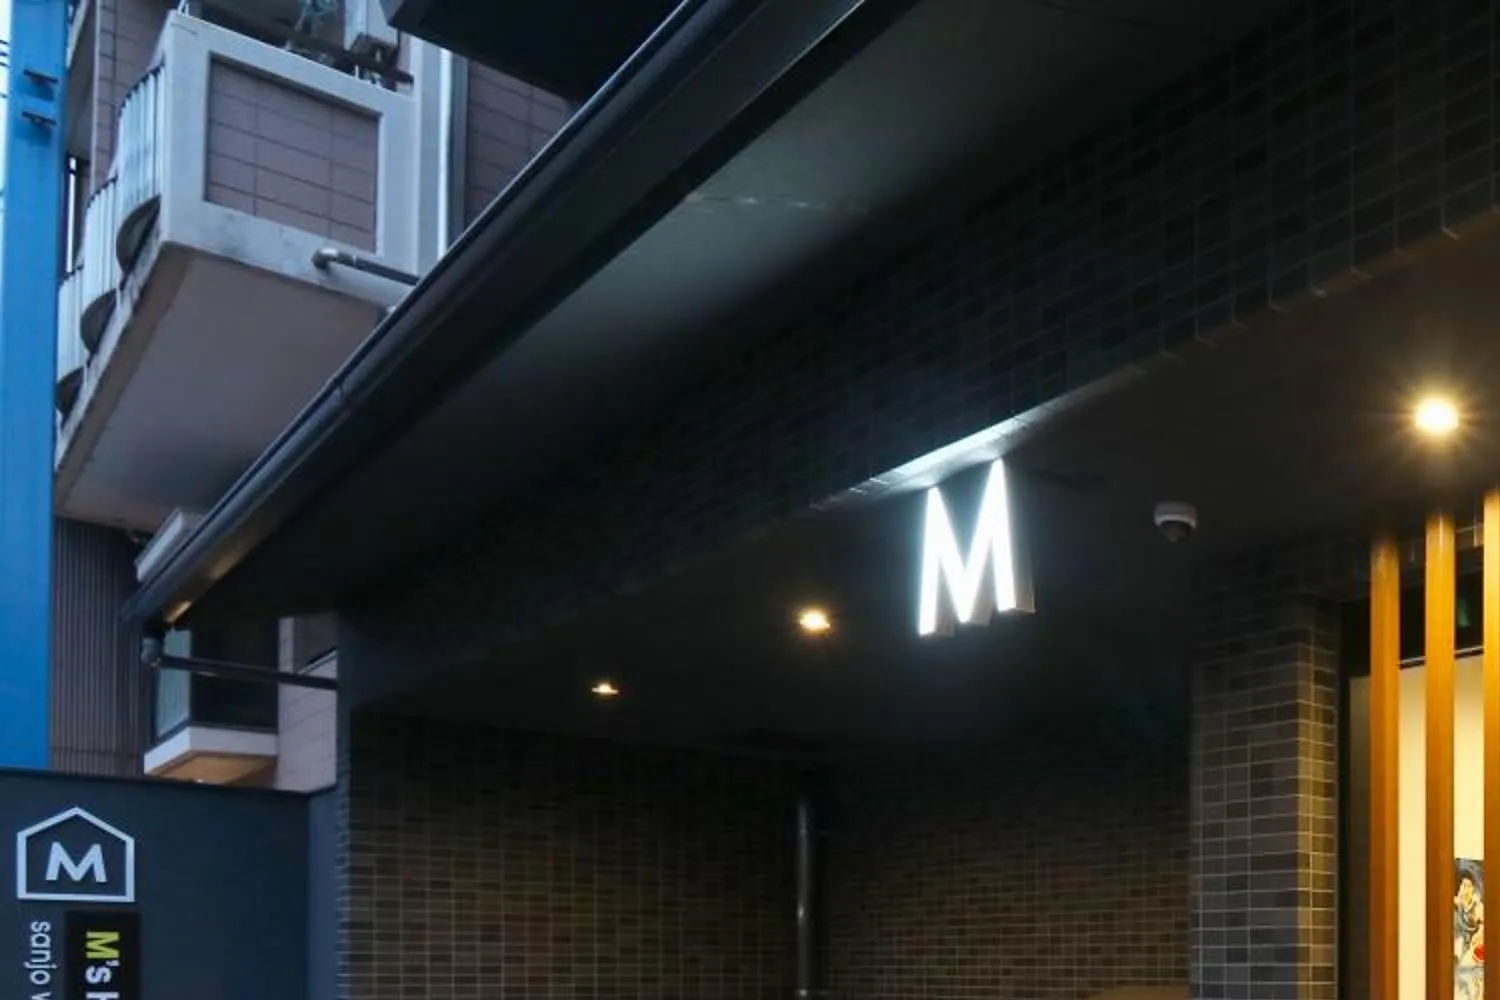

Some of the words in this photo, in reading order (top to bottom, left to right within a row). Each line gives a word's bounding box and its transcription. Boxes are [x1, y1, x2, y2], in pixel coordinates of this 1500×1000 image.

[918, 458, 1022, 636] M
[45, 842, 108, 883] M
[24, 920, 58, 986] sanjo
[85, 931, 121, 985] M's
